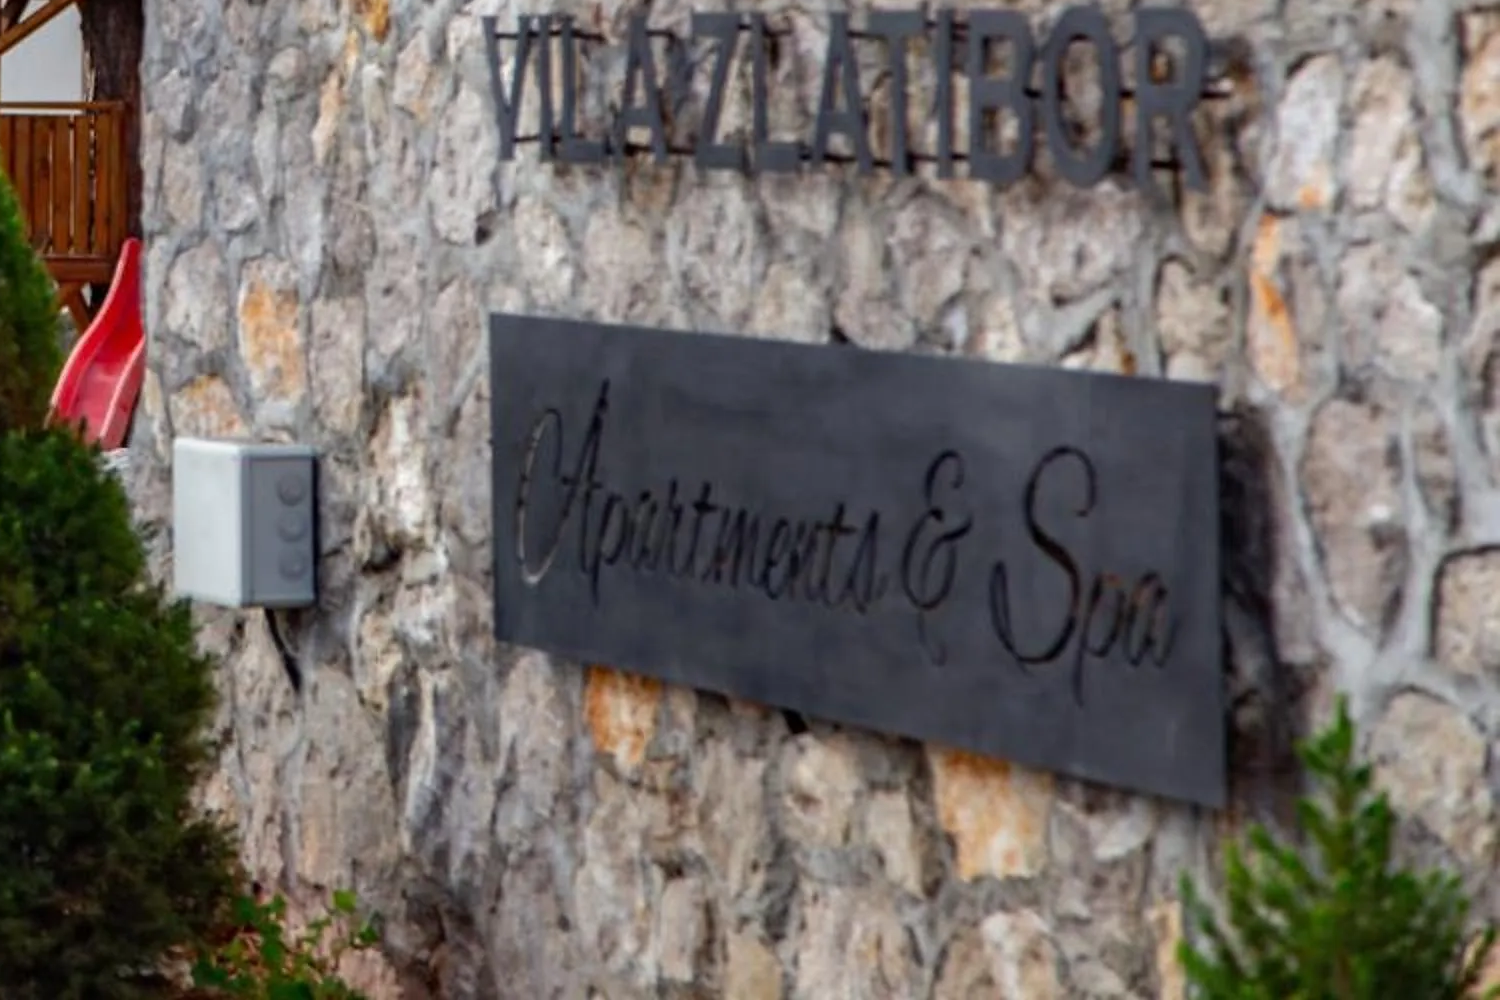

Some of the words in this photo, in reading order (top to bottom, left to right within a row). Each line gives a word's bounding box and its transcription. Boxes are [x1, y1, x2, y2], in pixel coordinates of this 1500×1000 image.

[482, 14, 670, 166] VILA
[690, 3, 1208, 194] ZLATIBOR
[516, 378, 888, 614] Apartments
[902, 450, 972, 666] &
[990, 446, 1180, 706] Spa
